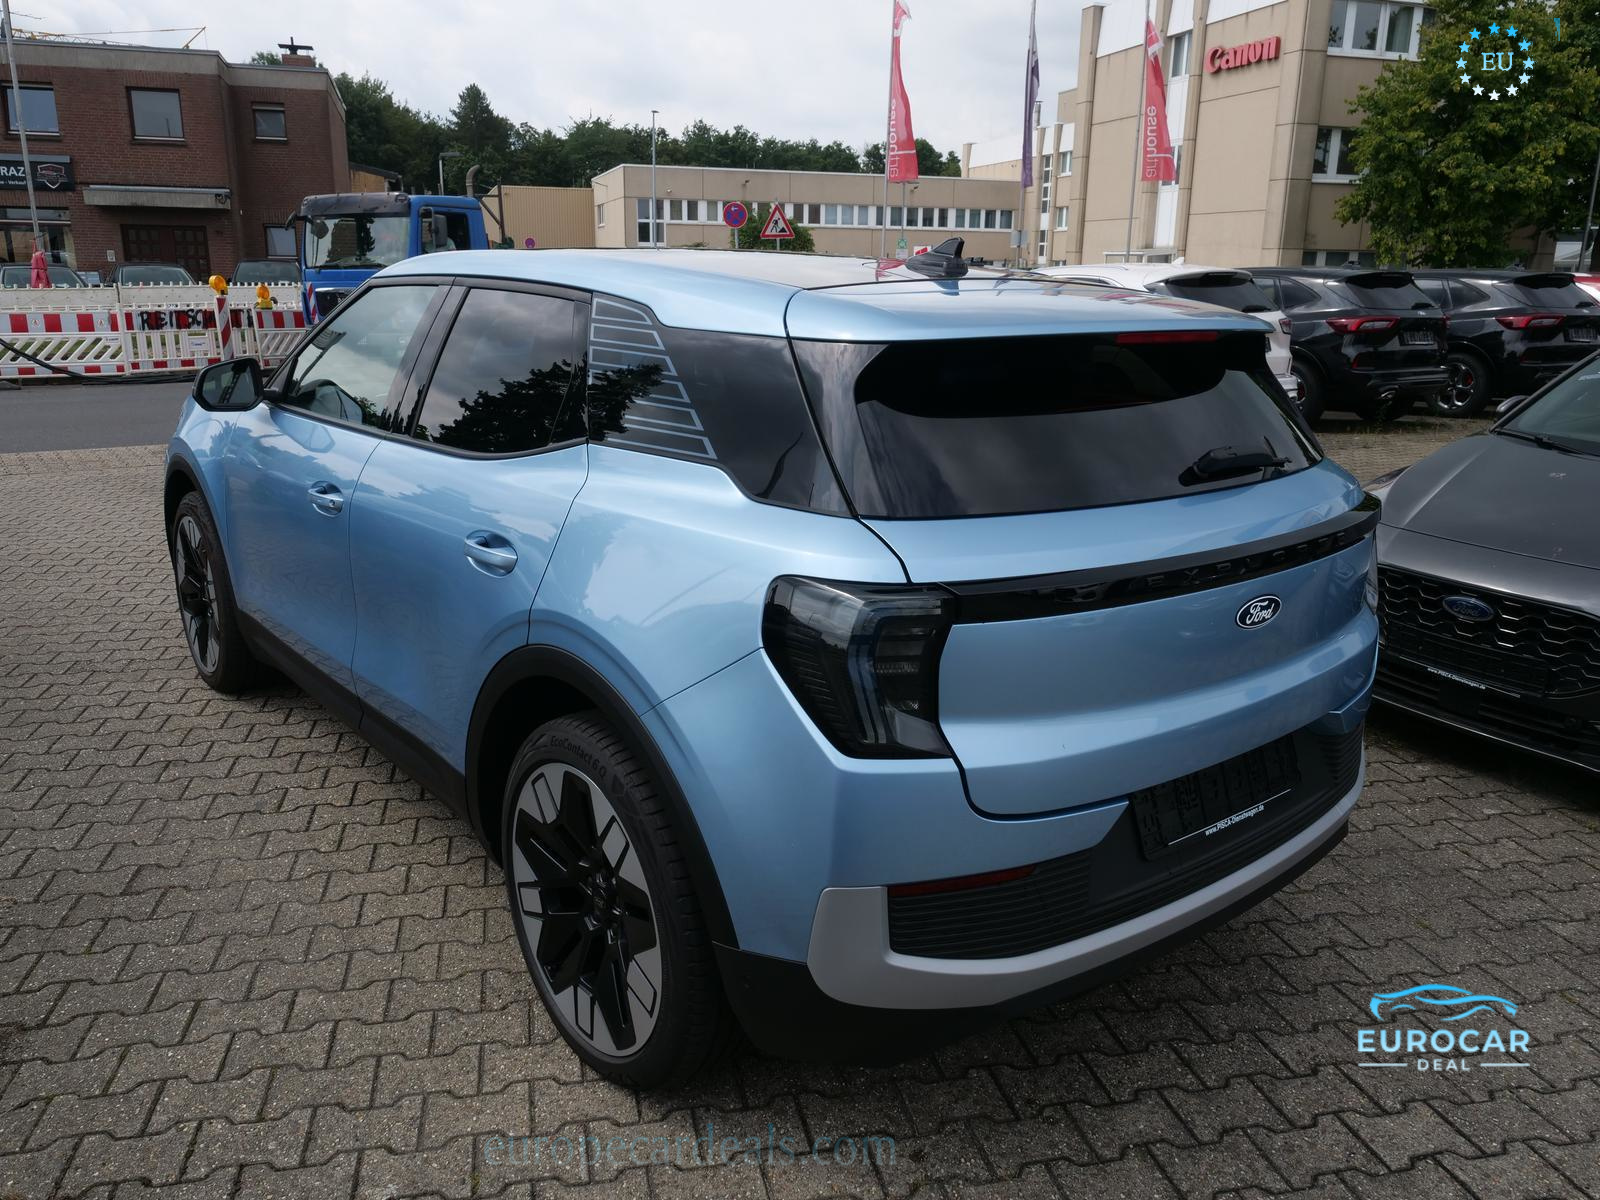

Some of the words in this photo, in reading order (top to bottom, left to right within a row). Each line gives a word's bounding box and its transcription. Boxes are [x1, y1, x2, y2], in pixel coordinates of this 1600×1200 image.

[1203, 36, 1281, 74] Canon
[0, 166, 26, 177] RAZ
[1243, 598, 1276, 625] Ford
[550, 735, 593, 764] EcoContact
[592, 759, 600, 770] 6
